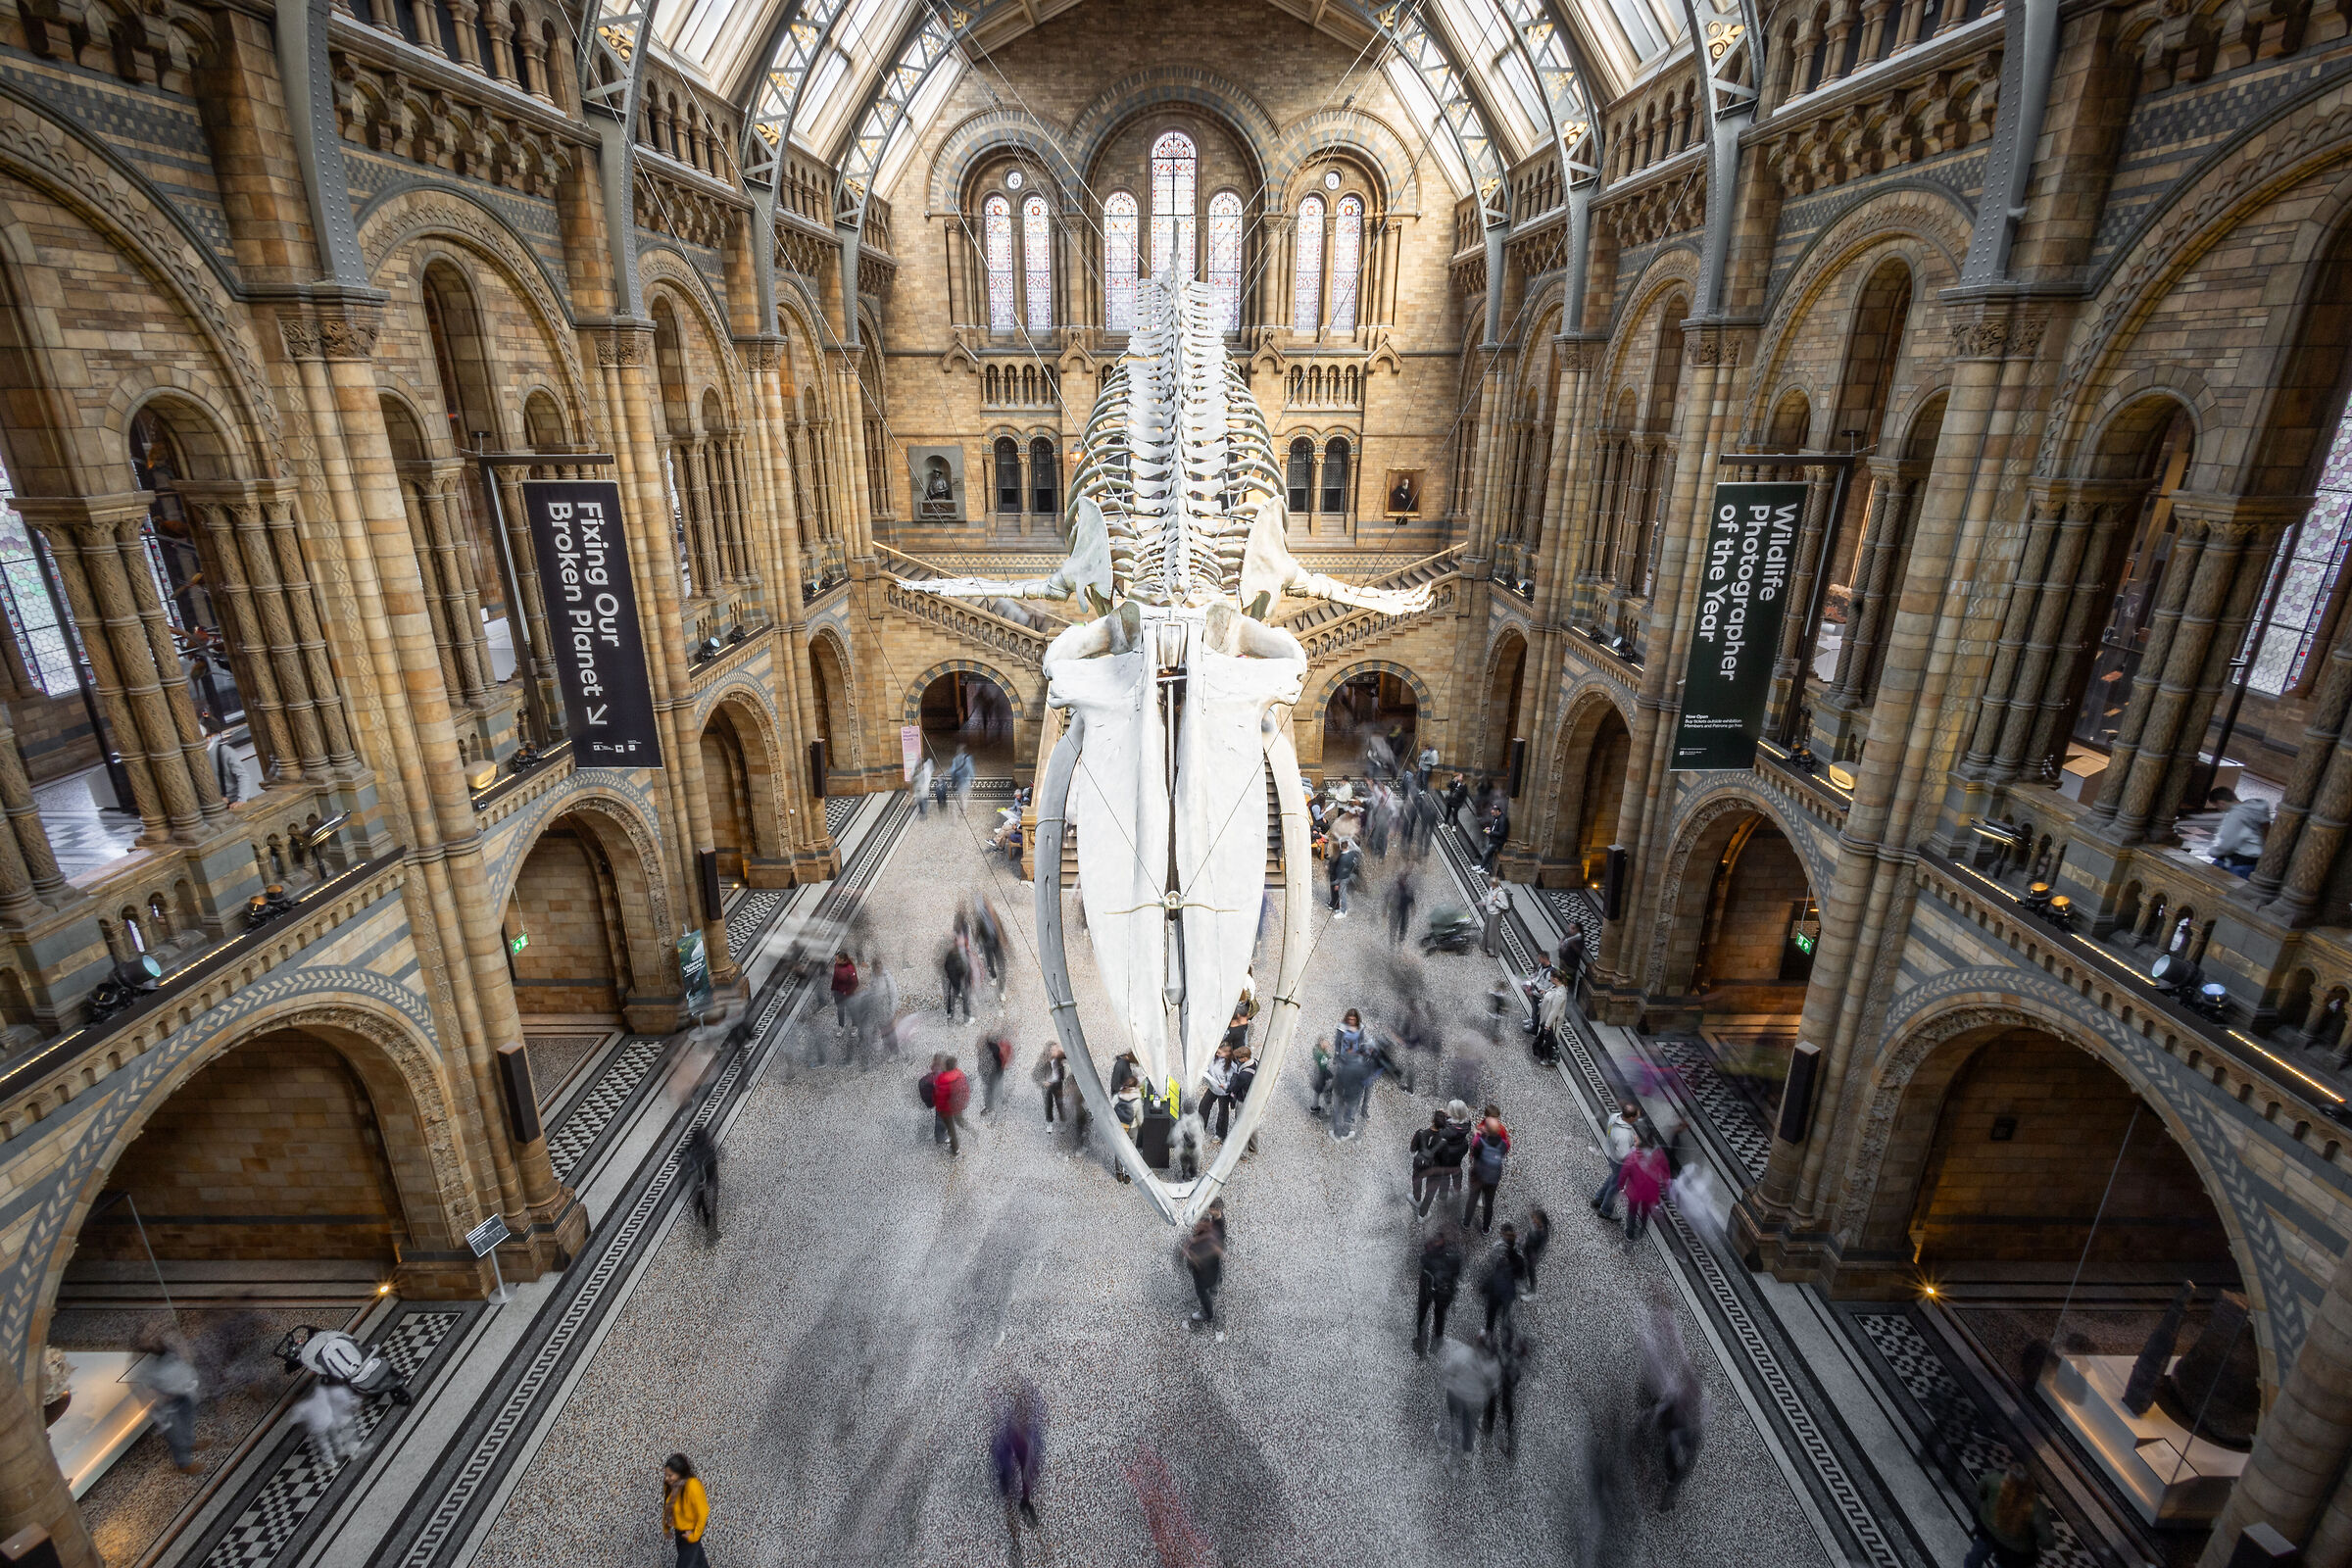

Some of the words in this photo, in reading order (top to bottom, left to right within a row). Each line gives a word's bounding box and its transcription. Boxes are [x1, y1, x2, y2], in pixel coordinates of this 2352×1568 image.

[1717, 504, 1740, 533] of
[1759, 503, 1797, 602] Wildlife
[576, 502, 610, 586] Fixing
[594, 592, 620, 648] Our
[1708, 537, 1735, 581] the
[1719, 505, 1771, 681] Photographer
[547, 502, 582, 602] Broken
[567, 610, 604, 697] Planet
[1698, 583, 1729, 643] Year
[686, 962, 702, 973] Nature
